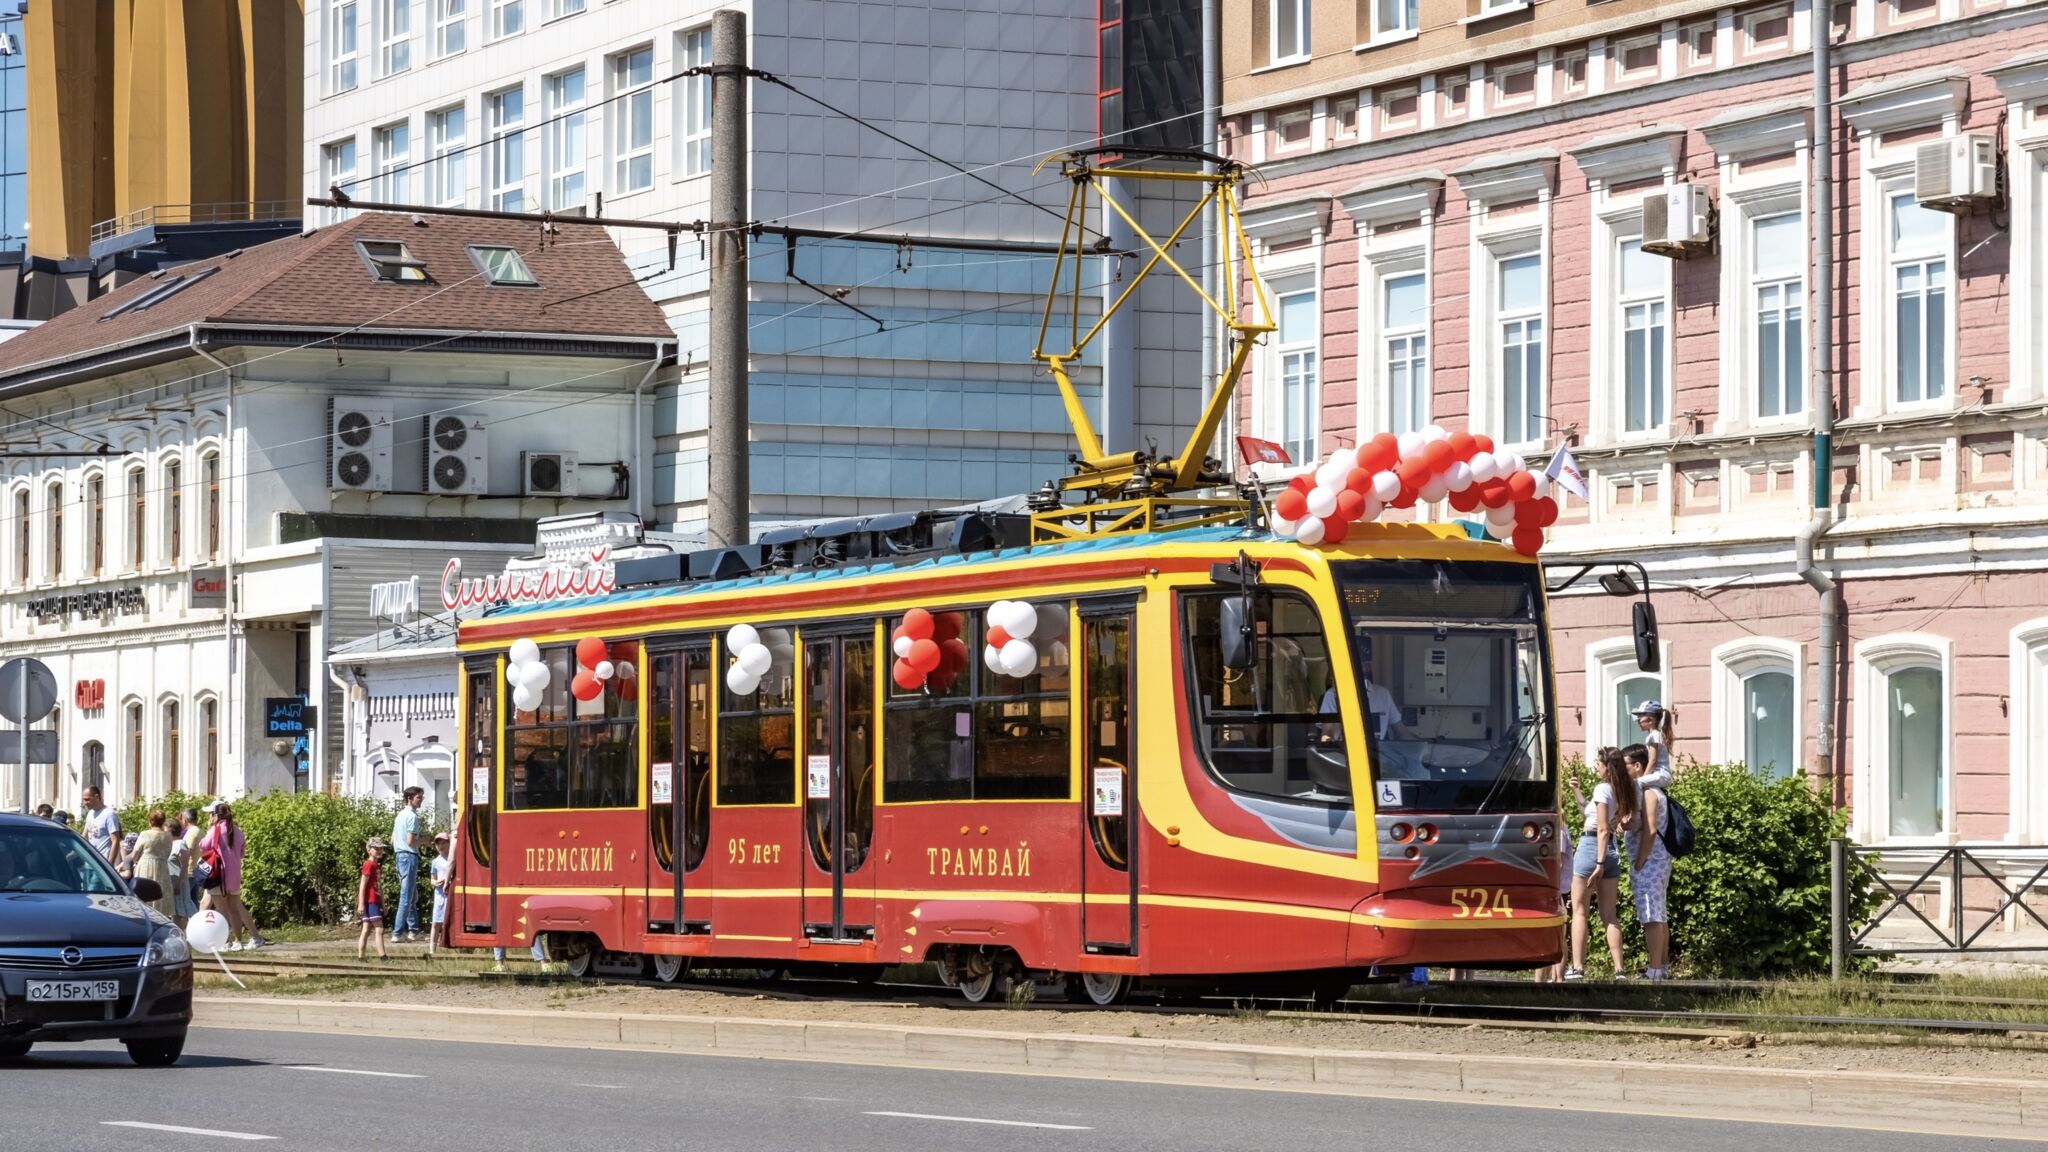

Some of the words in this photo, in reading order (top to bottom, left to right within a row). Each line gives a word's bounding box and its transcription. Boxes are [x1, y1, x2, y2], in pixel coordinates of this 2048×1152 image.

[525, 840, 614, 872] ПЕРМСКИЙ
[729, 838, 745, 864] 95
[752, 844, 781, 864] лет
[927, 840, 1031, 876] ТРАМВАЙ
[1451, 888, 1513, 918] 524
[95, 982, 115, 993] 159
